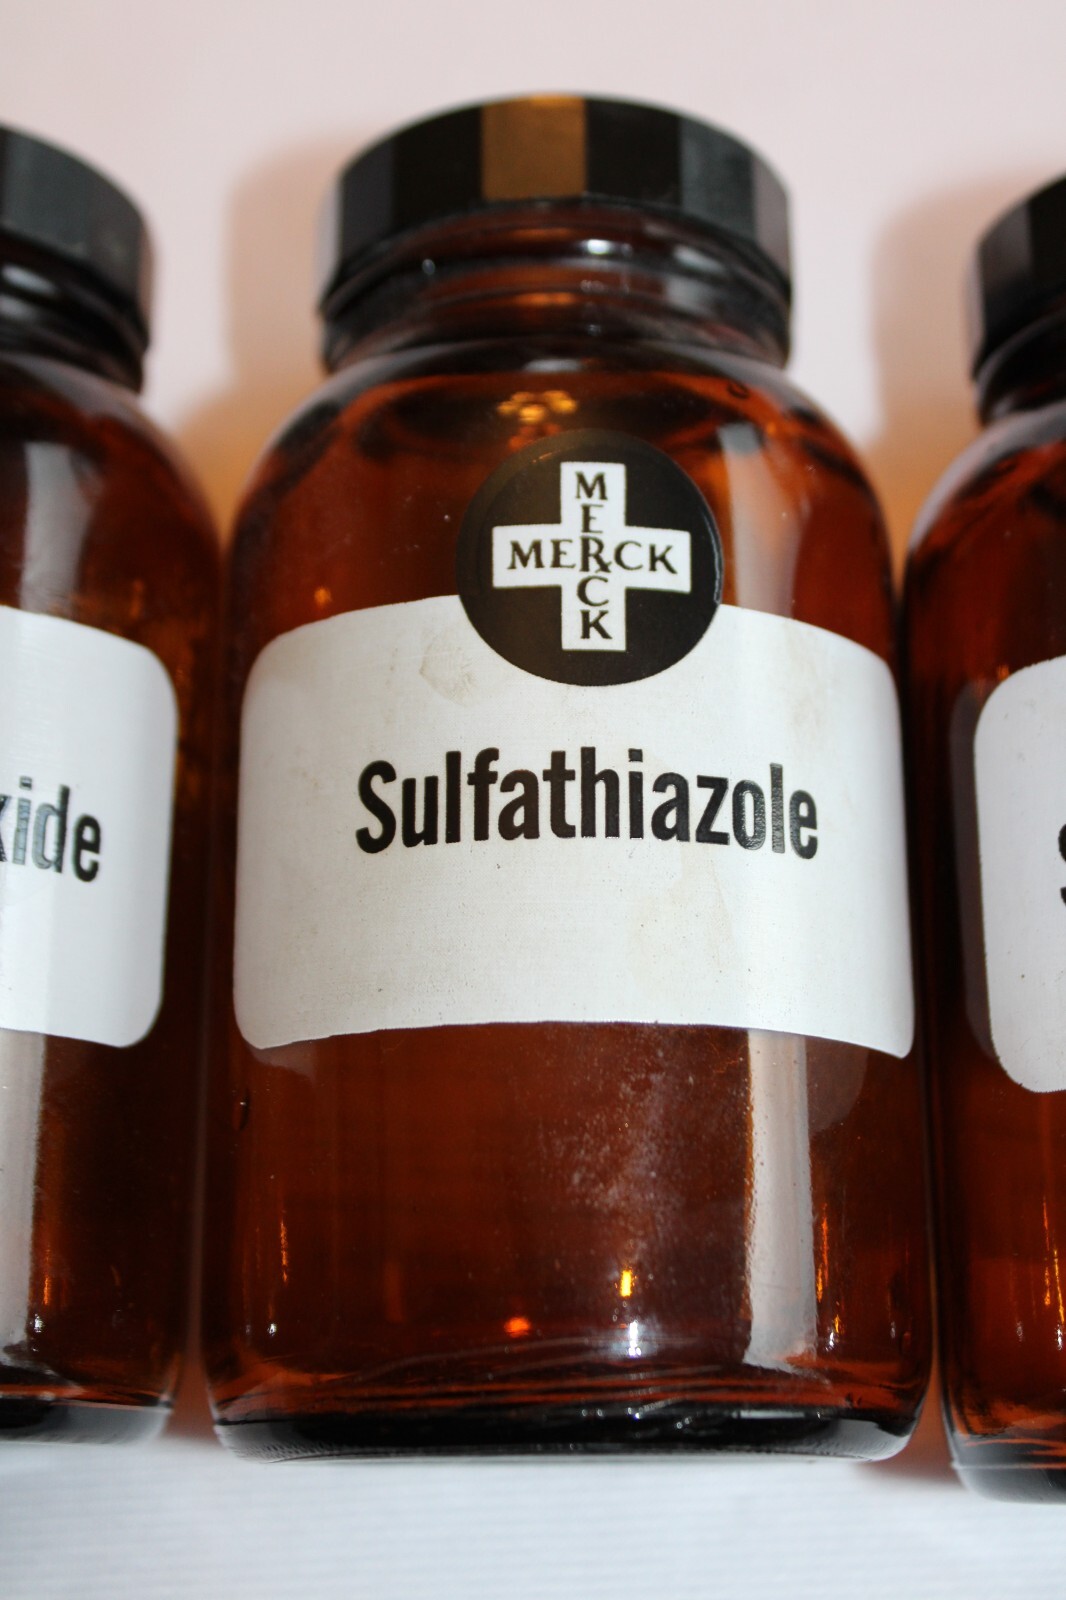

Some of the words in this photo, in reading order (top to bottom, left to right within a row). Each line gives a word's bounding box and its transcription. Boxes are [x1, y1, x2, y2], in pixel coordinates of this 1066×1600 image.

[507, 536, 678, 575] MERCK
[575, 471, 613, 640] MERCK
[356, 746, 818, 860] Sulfathiazole
